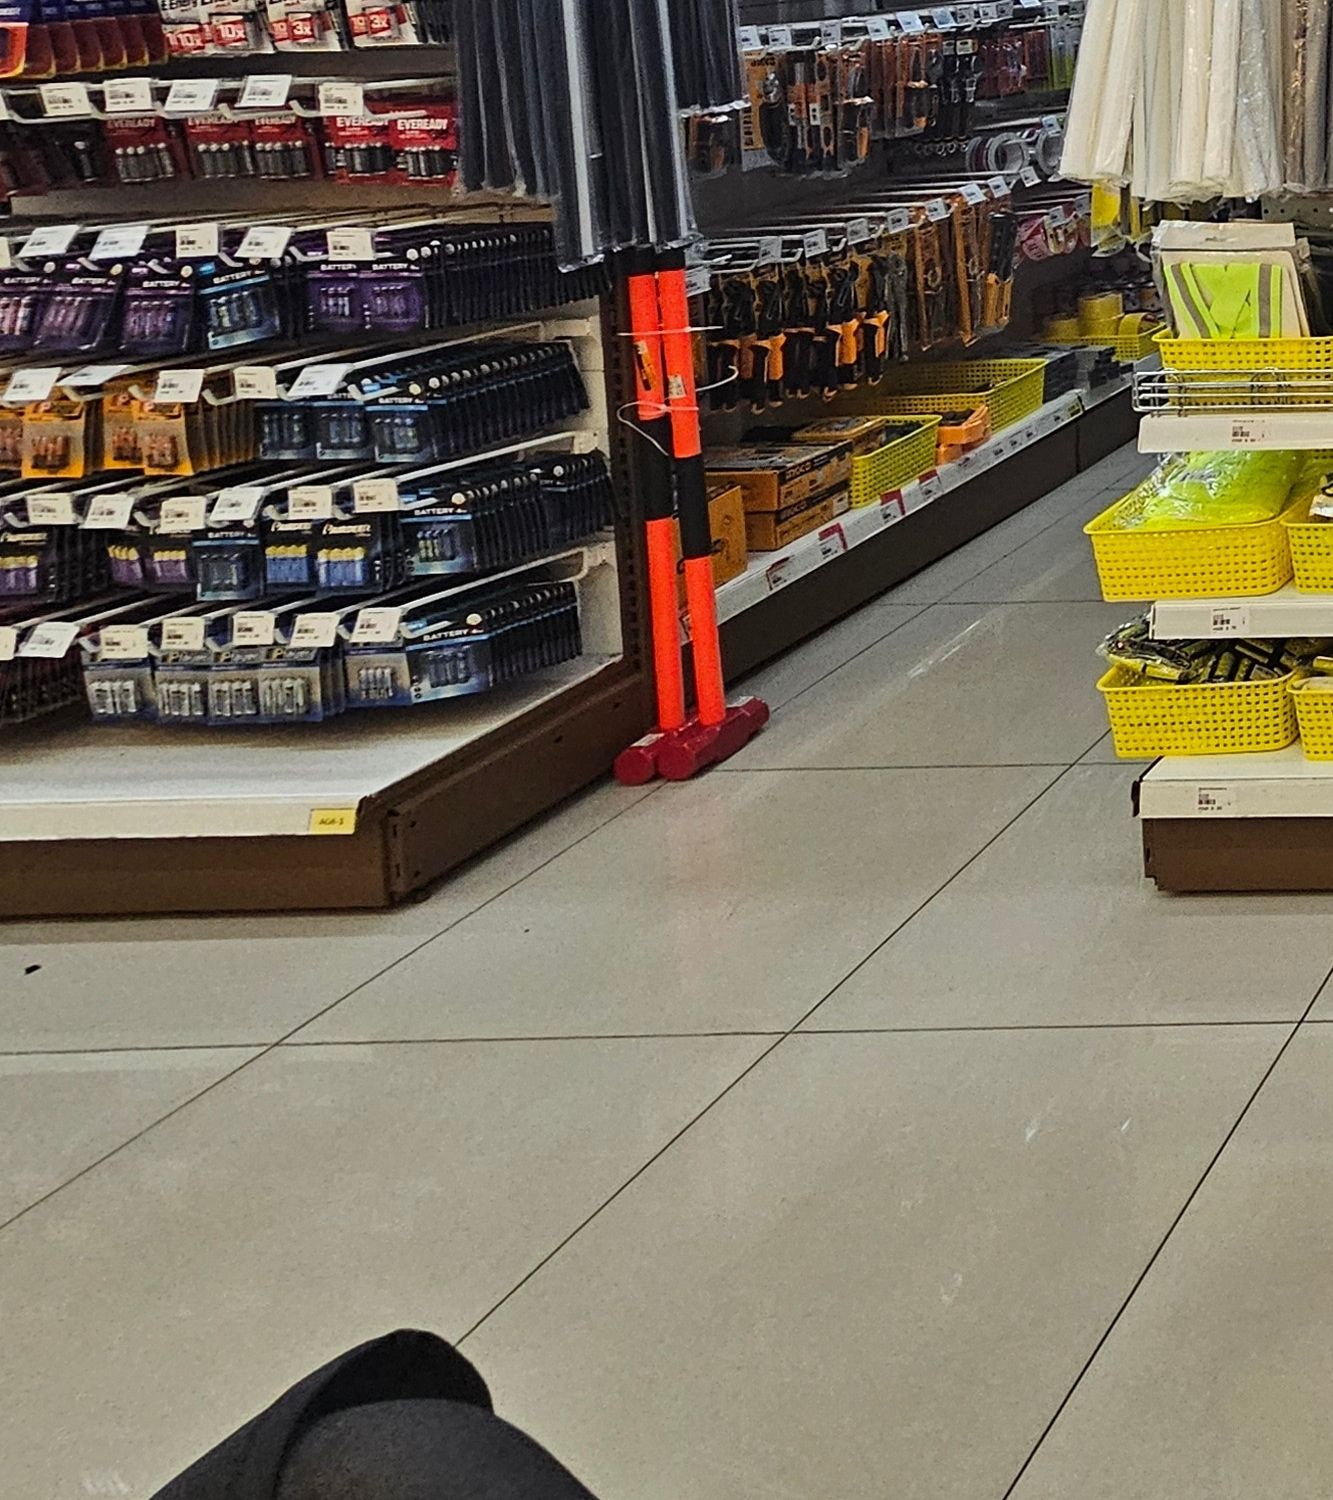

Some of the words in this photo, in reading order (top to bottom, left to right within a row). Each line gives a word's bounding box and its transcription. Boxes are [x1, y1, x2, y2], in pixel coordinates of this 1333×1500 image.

[291, 21, 313, 36] 3x
[369, 14, 390, 29] 3x
[216, 22, 246, 41] 10x
[336, 115, 390, 128] EVEREADY
[396, 117, 448, 132] EVEREADY
